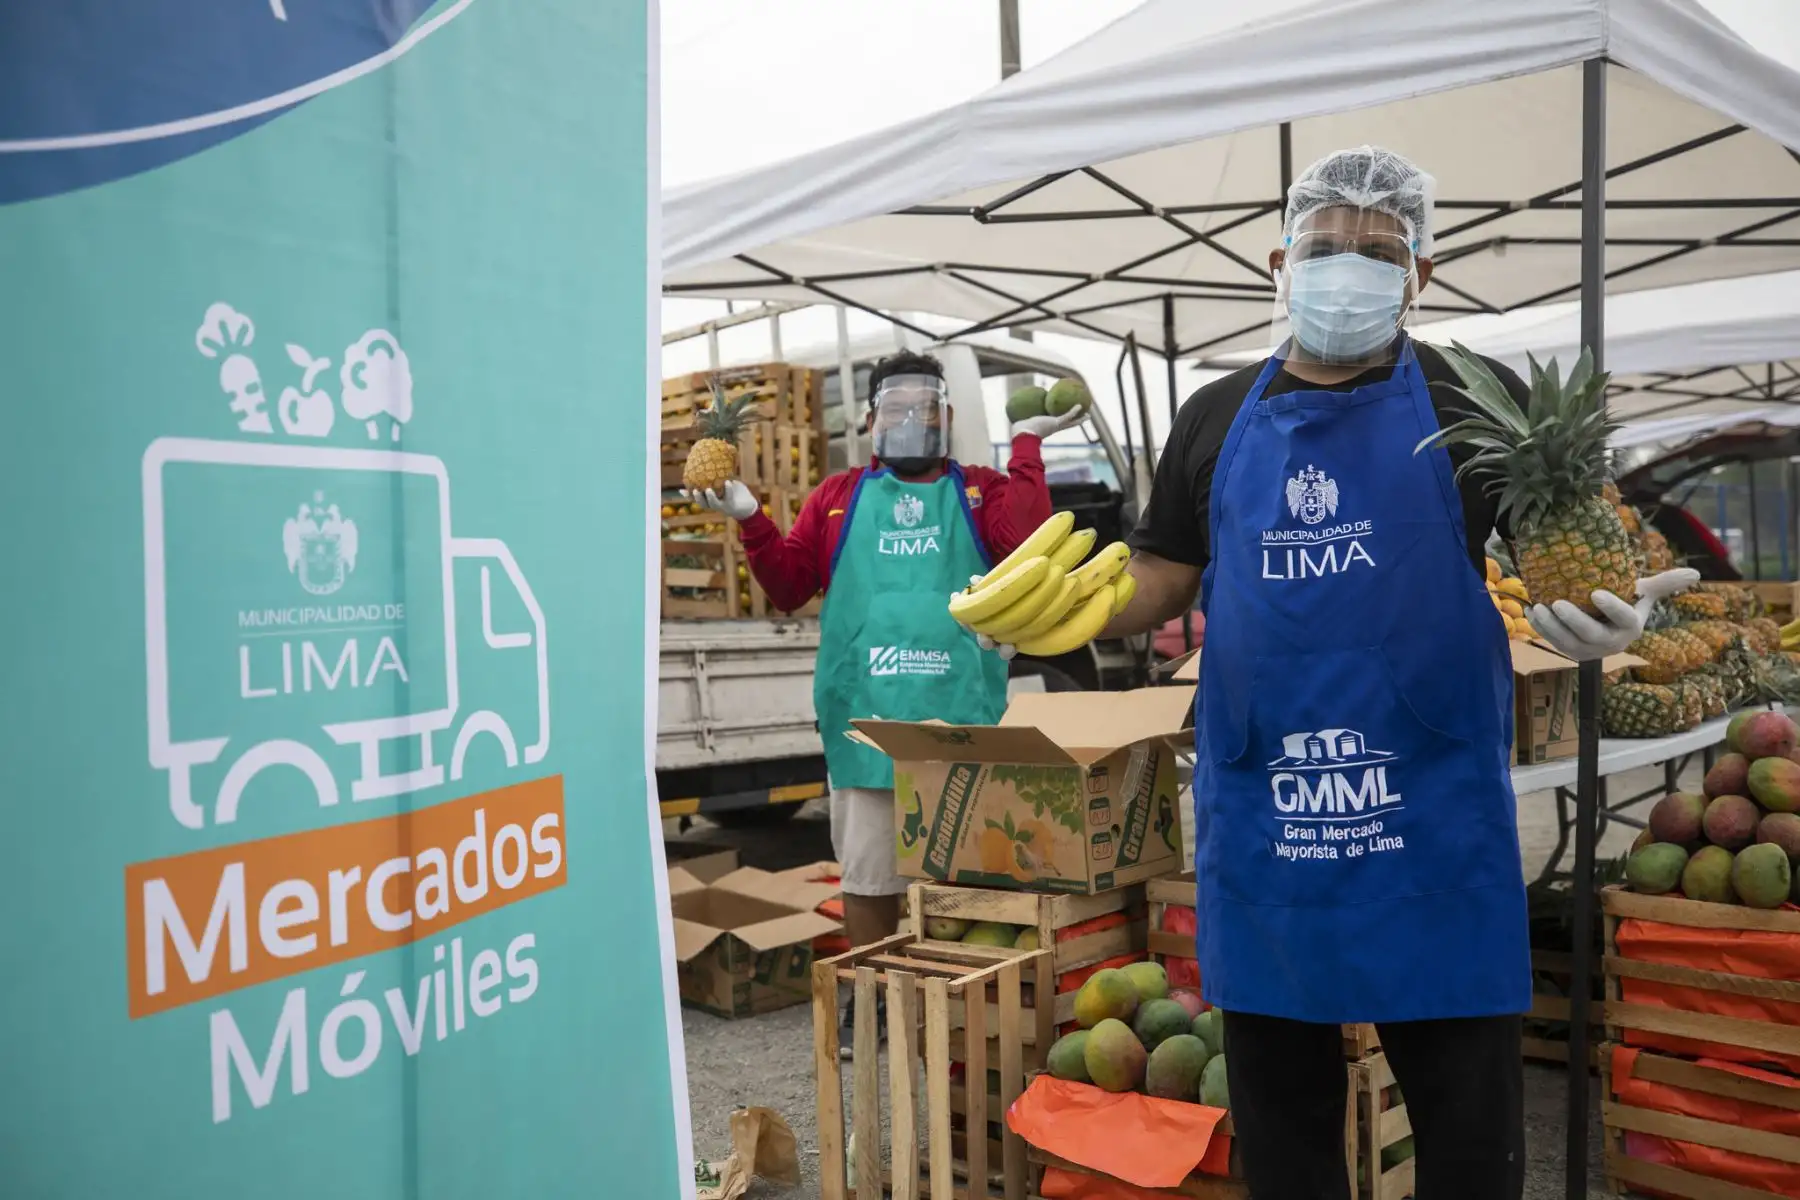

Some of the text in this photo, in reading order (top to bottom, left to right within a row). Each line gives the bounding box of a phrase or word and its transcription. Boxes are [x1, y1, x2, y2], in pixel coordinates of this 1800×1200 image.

[879, 536, 941, 556] LIMA
[1262, 520, 1373, 541] MUNICIPALIDAD DE
[1262, 541, 1377, 579] LIMA
[238, 603, 405, 627] MUNICIPALIDAD DE
[240, 636, 410, 698] LIMA
[899, 649, 952, 662] EMMSA
[1271, 766, 1402, 813] GMML
[929, 766, 972, 869] Granadilla
[1284, 820, 1384, 841] Gran Mercado
[1275, 835, 1405, 862] Mayorista de Lima
[143, 809, 562, 998] Mercados
[209, 933, 540, 1125] Móviles
